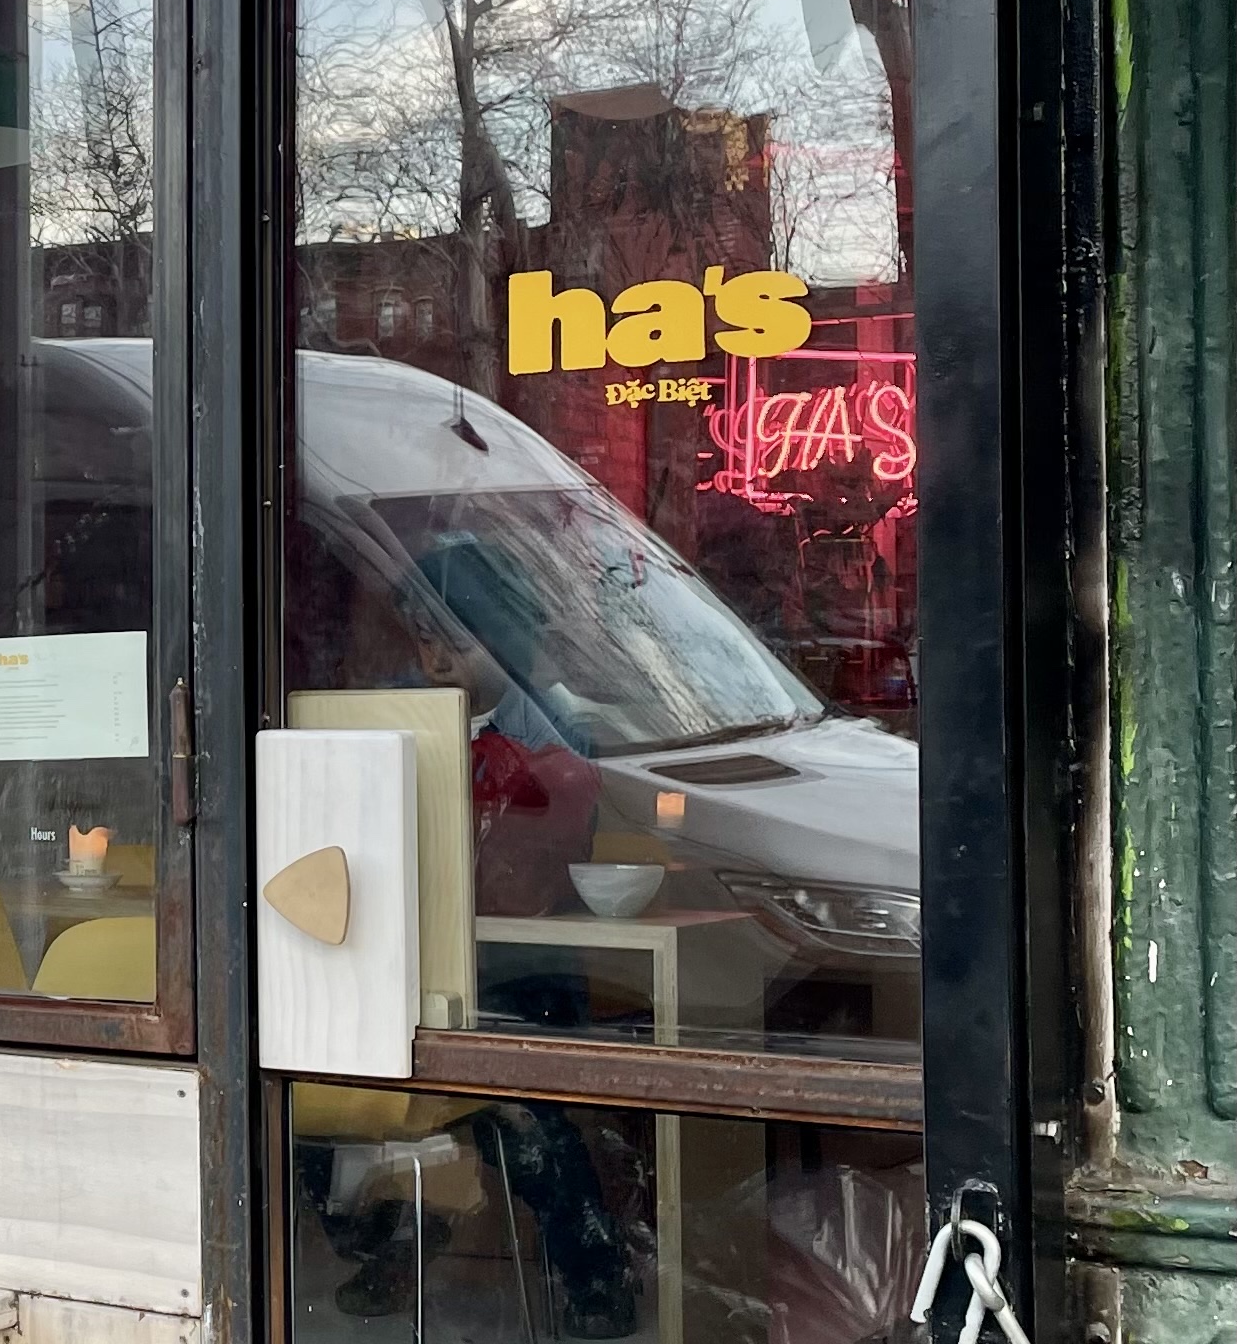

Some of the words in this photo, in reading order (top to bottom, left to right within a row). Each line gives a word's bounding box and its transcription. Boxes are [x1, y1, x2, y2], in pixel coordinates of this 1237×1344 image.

[508, 265, 812, 376] ha's
[605, 378, 656, 409] Đặc
[656, 377, 713, 408] Biệt
[30, 826, 56, 842] Hours
